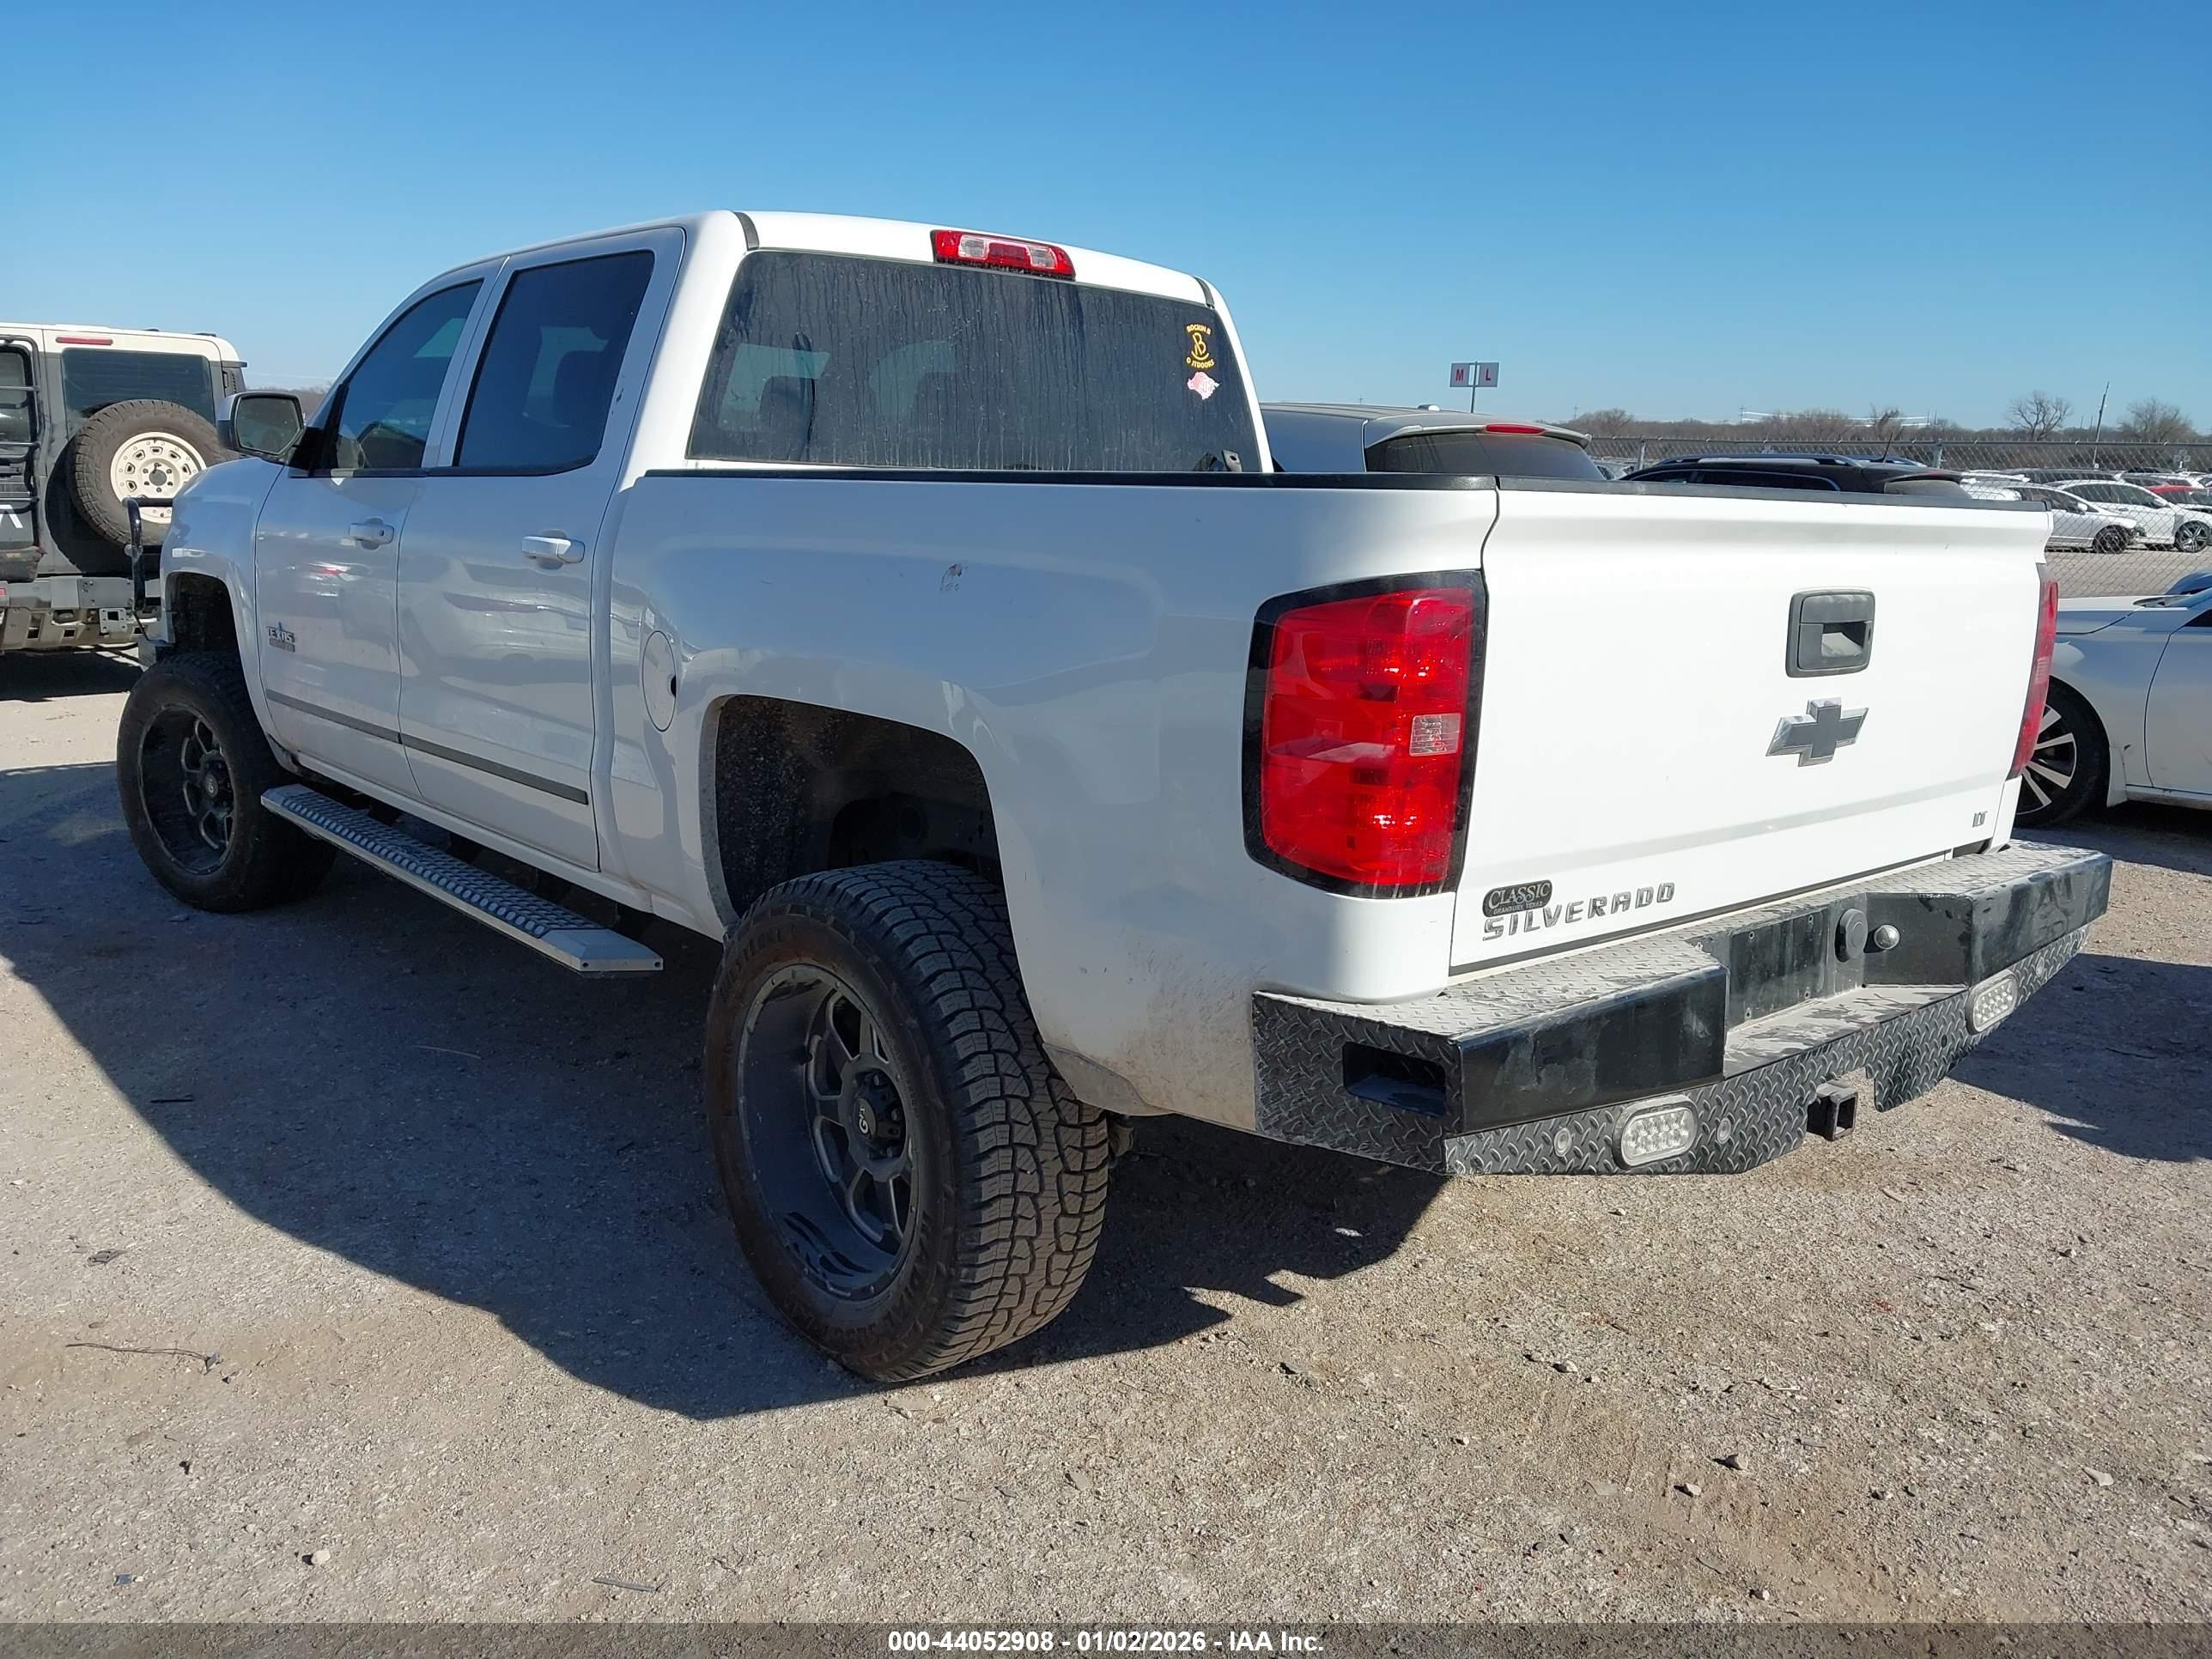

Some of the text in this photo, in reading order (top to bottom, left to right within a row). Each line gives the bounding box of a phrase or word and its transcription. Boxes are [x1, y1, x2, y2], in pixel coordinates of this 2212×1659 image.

[1455, 368, 1492, 381] M L
[1488, 882, 1551, 909] CLASSIC
[1482, 882, 1675, 941] SILVERADO
